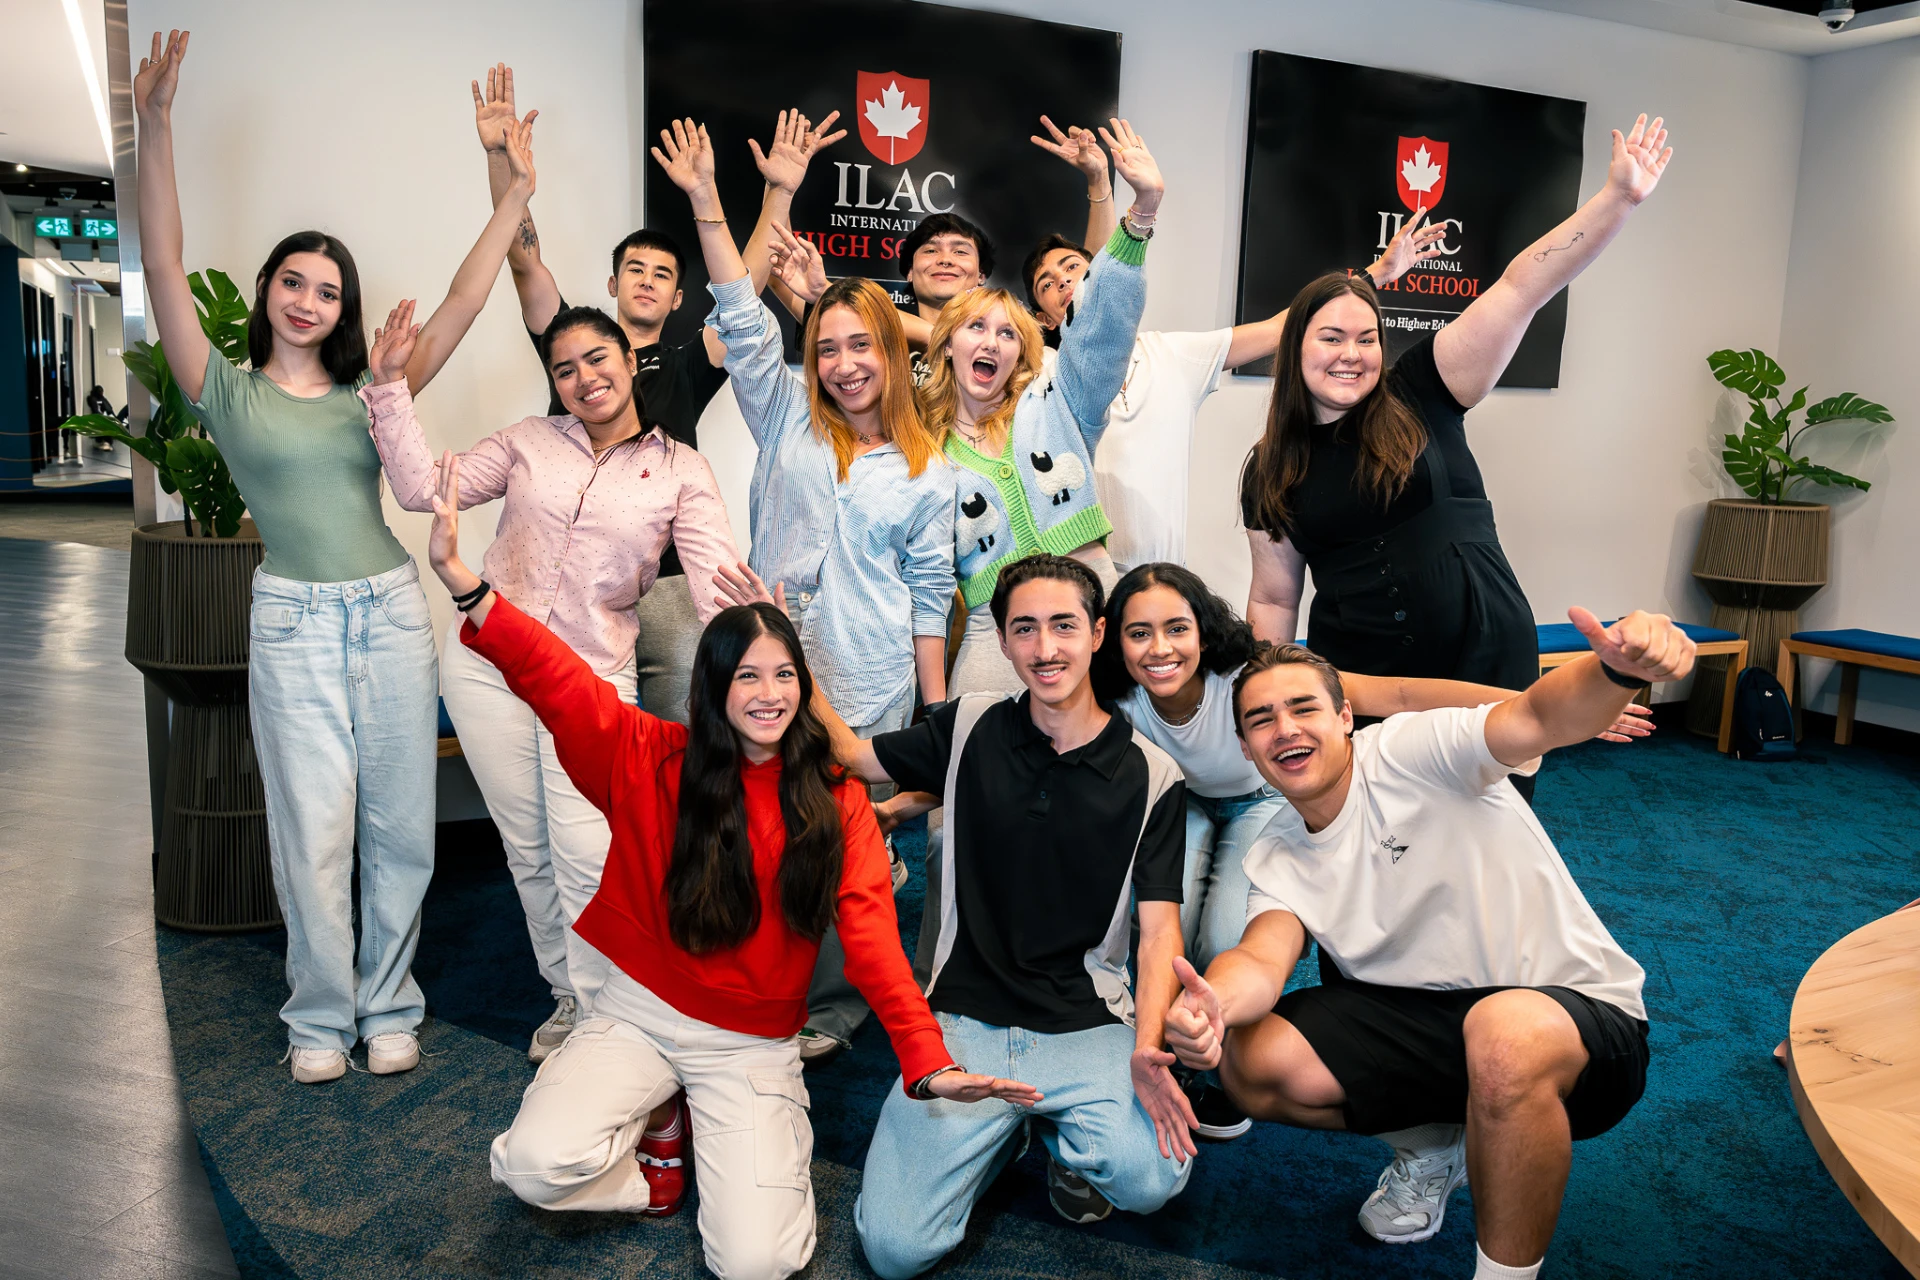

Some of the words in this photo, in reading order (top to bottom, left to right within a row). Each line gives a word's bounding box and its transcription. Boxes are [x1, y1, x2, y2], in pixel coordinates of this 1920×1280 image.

[834, 162, 956, 214] ILAC
[831, 214, 917, 232] INTERNATI
[1406, 273, 1482, 298] SCHOOL
[1385, 316, 1396, 328] to
[1397, 316, 1431, 332] Higher
